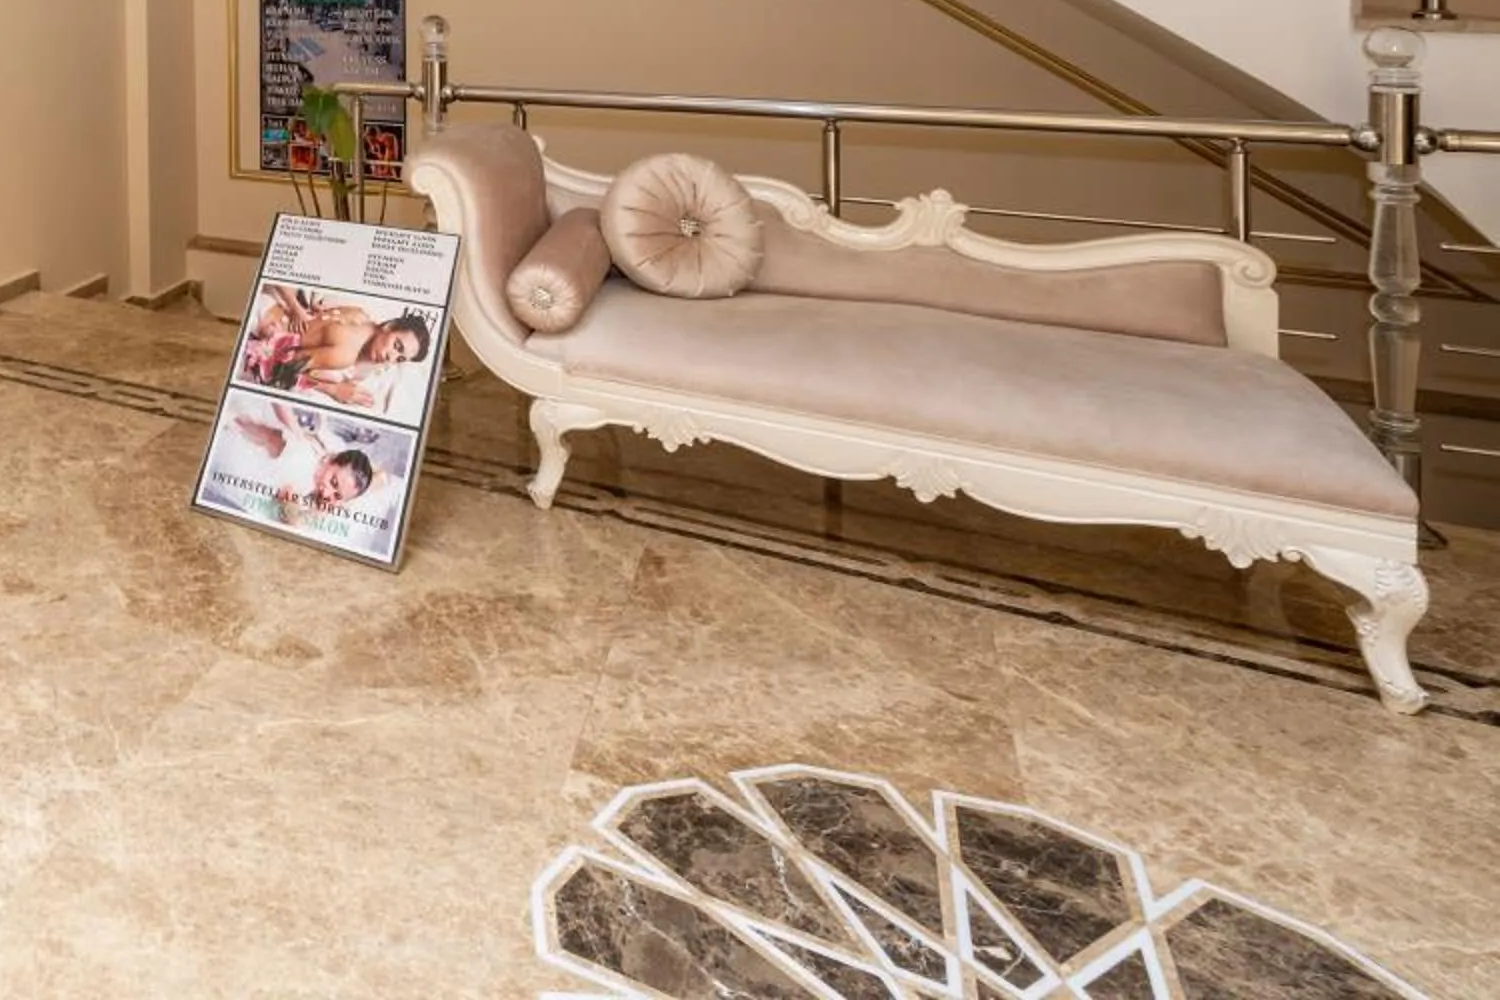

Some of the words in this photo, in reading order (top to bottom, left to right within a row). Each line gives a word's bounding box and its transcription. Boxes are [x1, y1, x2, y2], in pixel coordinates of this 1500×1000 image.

[212, 471, 299, 504] INTERSTELLAR
[302, 496, 351, 519] SPORTS
[353, 510, 389, 531] CLUB
